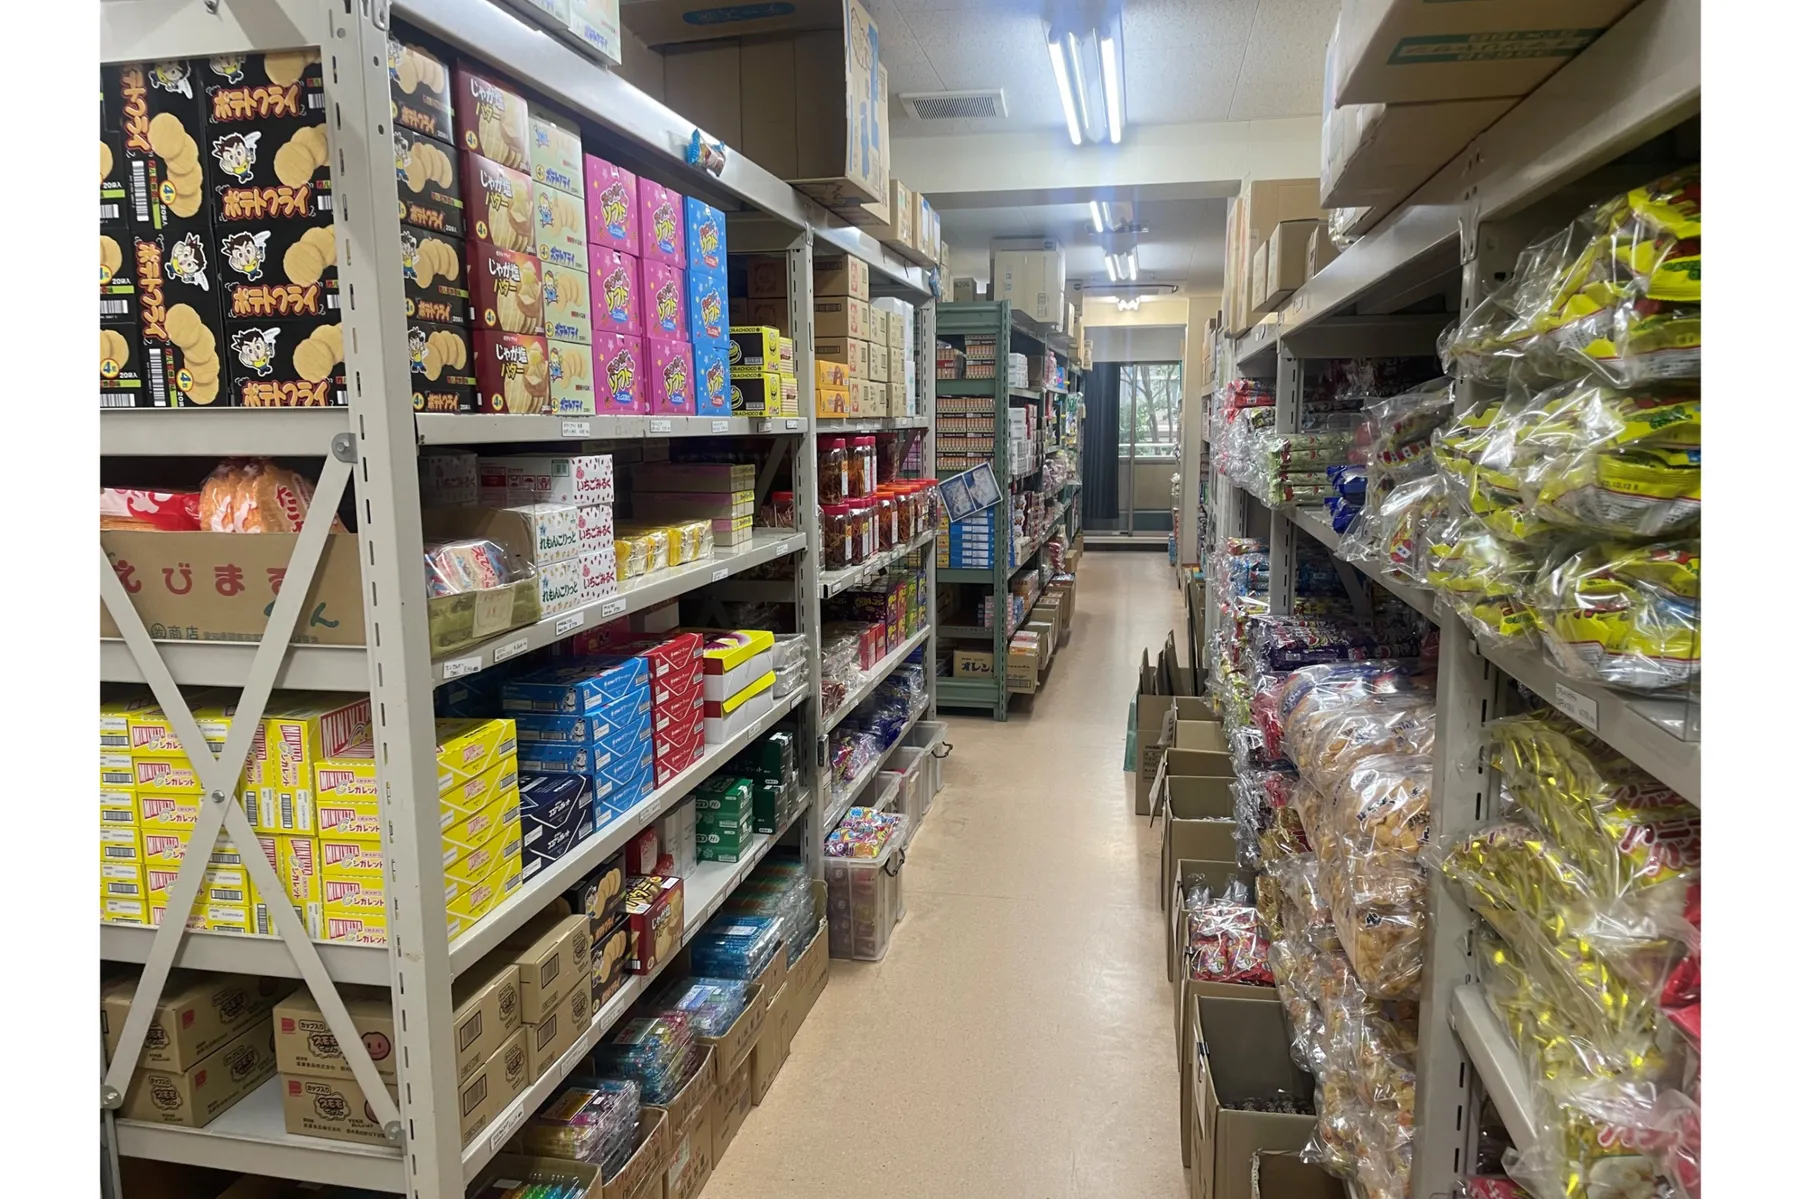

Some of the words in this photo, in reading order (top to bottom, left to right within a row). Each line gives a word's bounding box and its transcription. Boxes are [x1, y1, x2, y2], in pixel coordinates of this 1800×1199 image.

[214, 85, 299, 119] ポテトフライ
[222, 185, 310, 219] ポテトフライ
[488, 258, 520, 282] じゃが塩
[137, 242, 167, 341] ポテトフライ
[493, 279, 517, 297] バター
[232, 284, 319, 316] ポテトフライ
[495, 343, 528, 364] じゃが塩
[501, 362, 524, 380] バター
[242, 380, 329, 406] ポテトフライ
[577, 477, 612, 492] いちごみるく
[540, 535, 577, 550] れもんこりっと
[578, 526, 612, 541] いちごみるく
[583, 572, 615, 590] いちごみるく
[542, 583, 579, 603] れもんこりっと
[133, 727, 165, 747] MINIVITA
[280, 725, 302, 761] MINIVITA
[138, 763, 171, 783] MINIVITA
[320, 771, 353, 791] MINIVITA
[143, 799, 175, 819] MINIVITA
[322, 809, 355, 829] MINIVITA
[290, 840, 313, 875] MINIVITA
[325, 844, 359, 864] MINIVITA
[327, 882, 360, 902] MINIVITA
[329, 919, 362, 938] MINIVITA
[318, 1097, 344, 1108] スモモ
